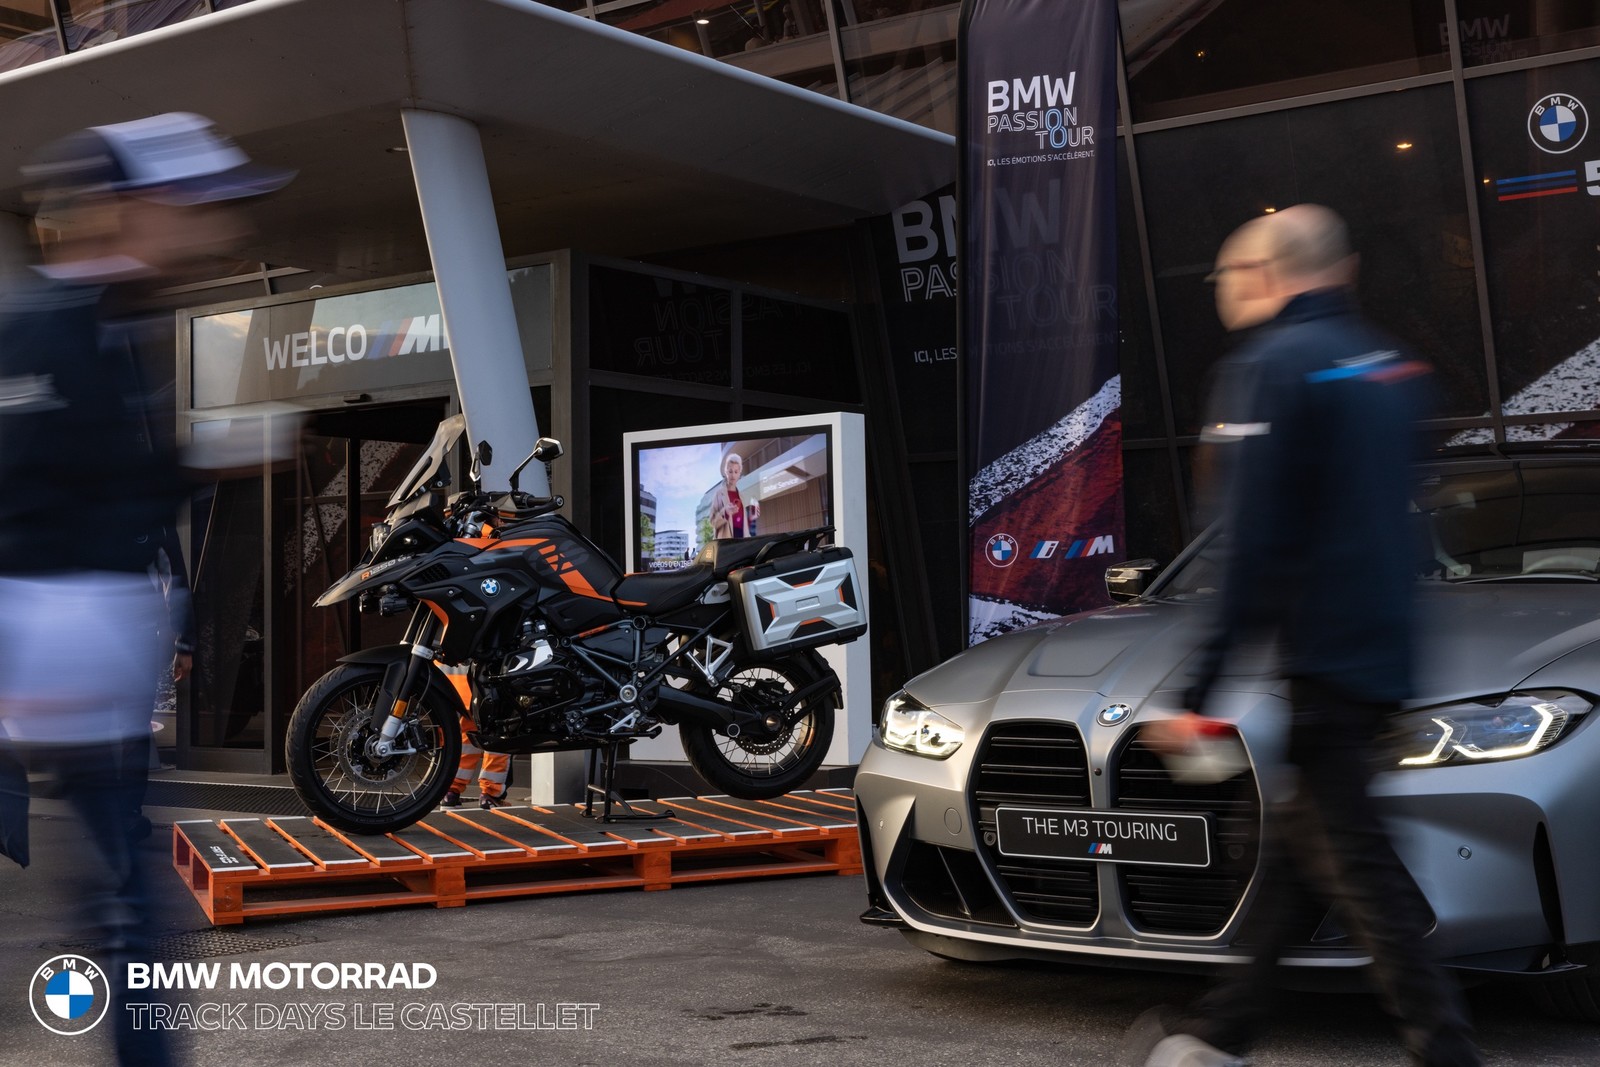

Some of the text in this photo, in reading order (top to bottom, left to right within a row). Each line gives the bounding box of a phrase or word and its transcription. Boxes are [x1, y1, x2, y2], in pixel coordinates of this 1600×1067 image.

[988, 71, 1076, 114] BMW
[1535, 96, 1579, 116] BMW
[987, 107, 1078, 134] PASSION
[1035, 125, 1094, 150] TOUR
[997, 158, 1011, 166] LES
[1011, 155, 1047, 165] ÉMOTIONS
[913, 349, 933, 364] ICI,
[934, 346, 958, 362] LES
[990, 535, 1014, 545] BMW
[1086, 535, 1114, 557] M
[1022, 816, 1178, 842] THE M3 TOURING
